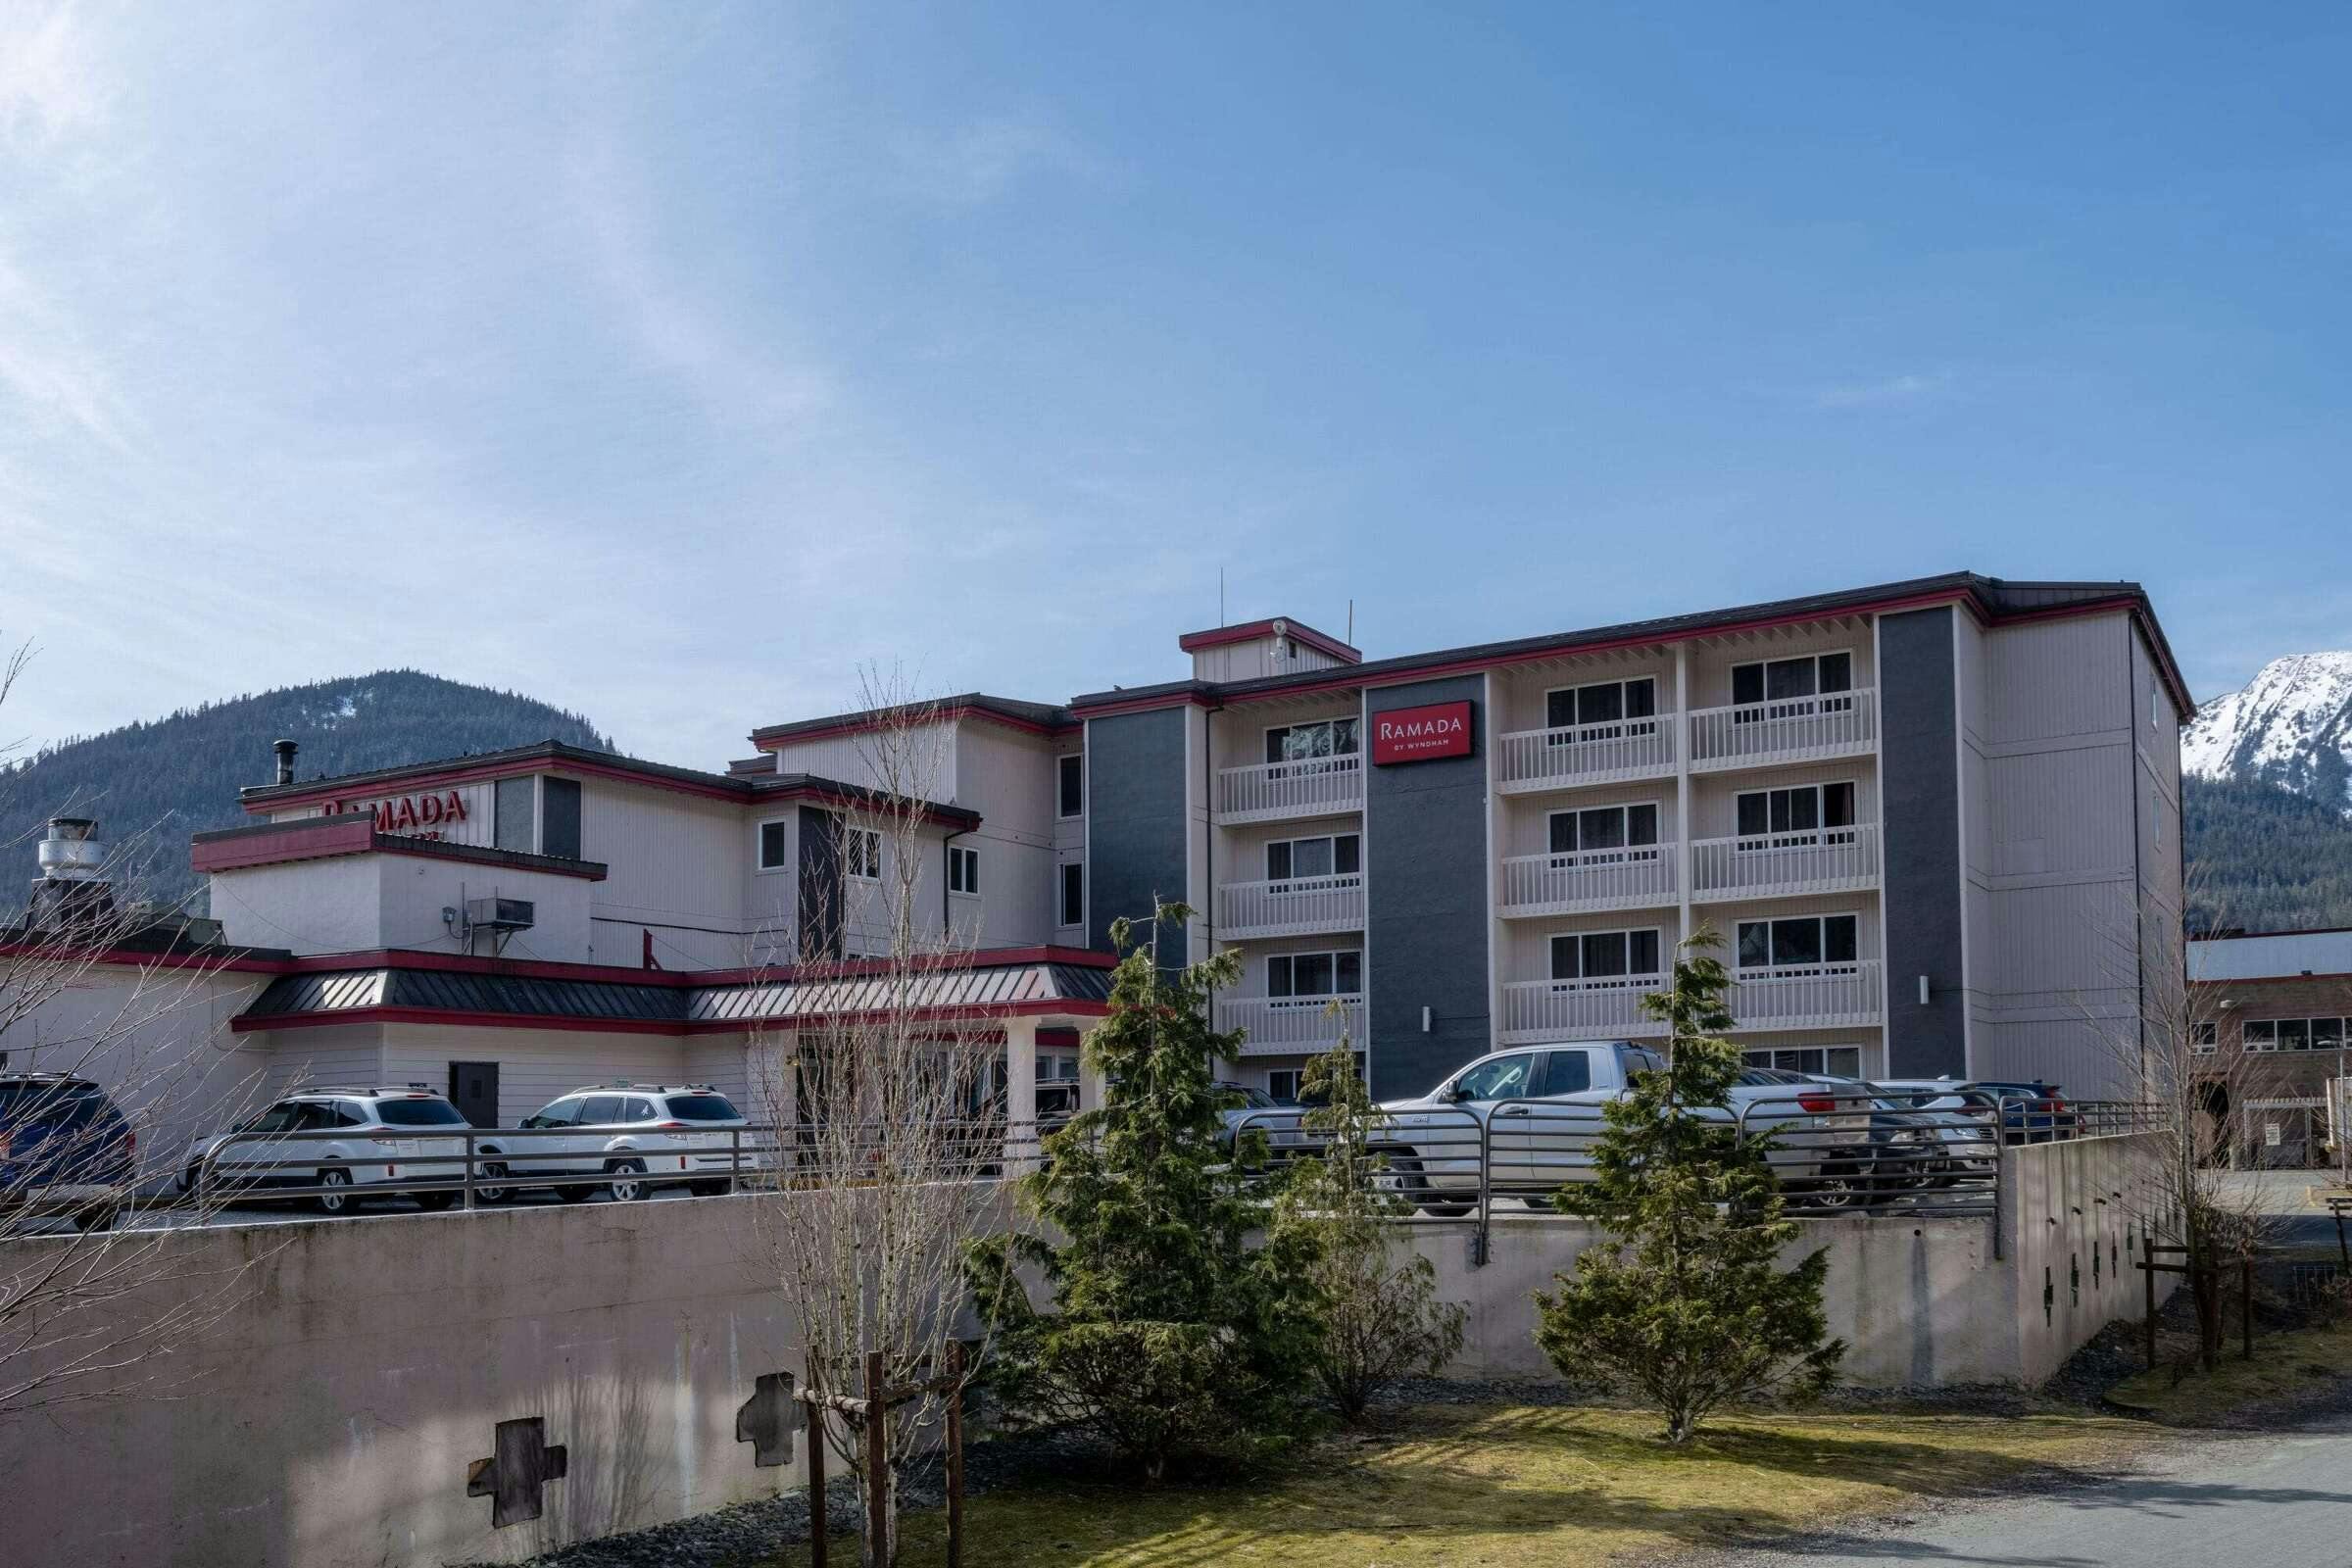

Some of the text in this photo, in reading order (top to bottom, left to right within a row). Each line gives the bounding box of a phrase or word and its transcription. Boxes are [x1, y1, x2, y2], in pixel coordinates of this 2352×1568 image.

[1381, 717, 1461, 740] RAMADA
[1407, 739, 1448, 750] WYNDHAM
[322, 790, 466, 831] MADA
